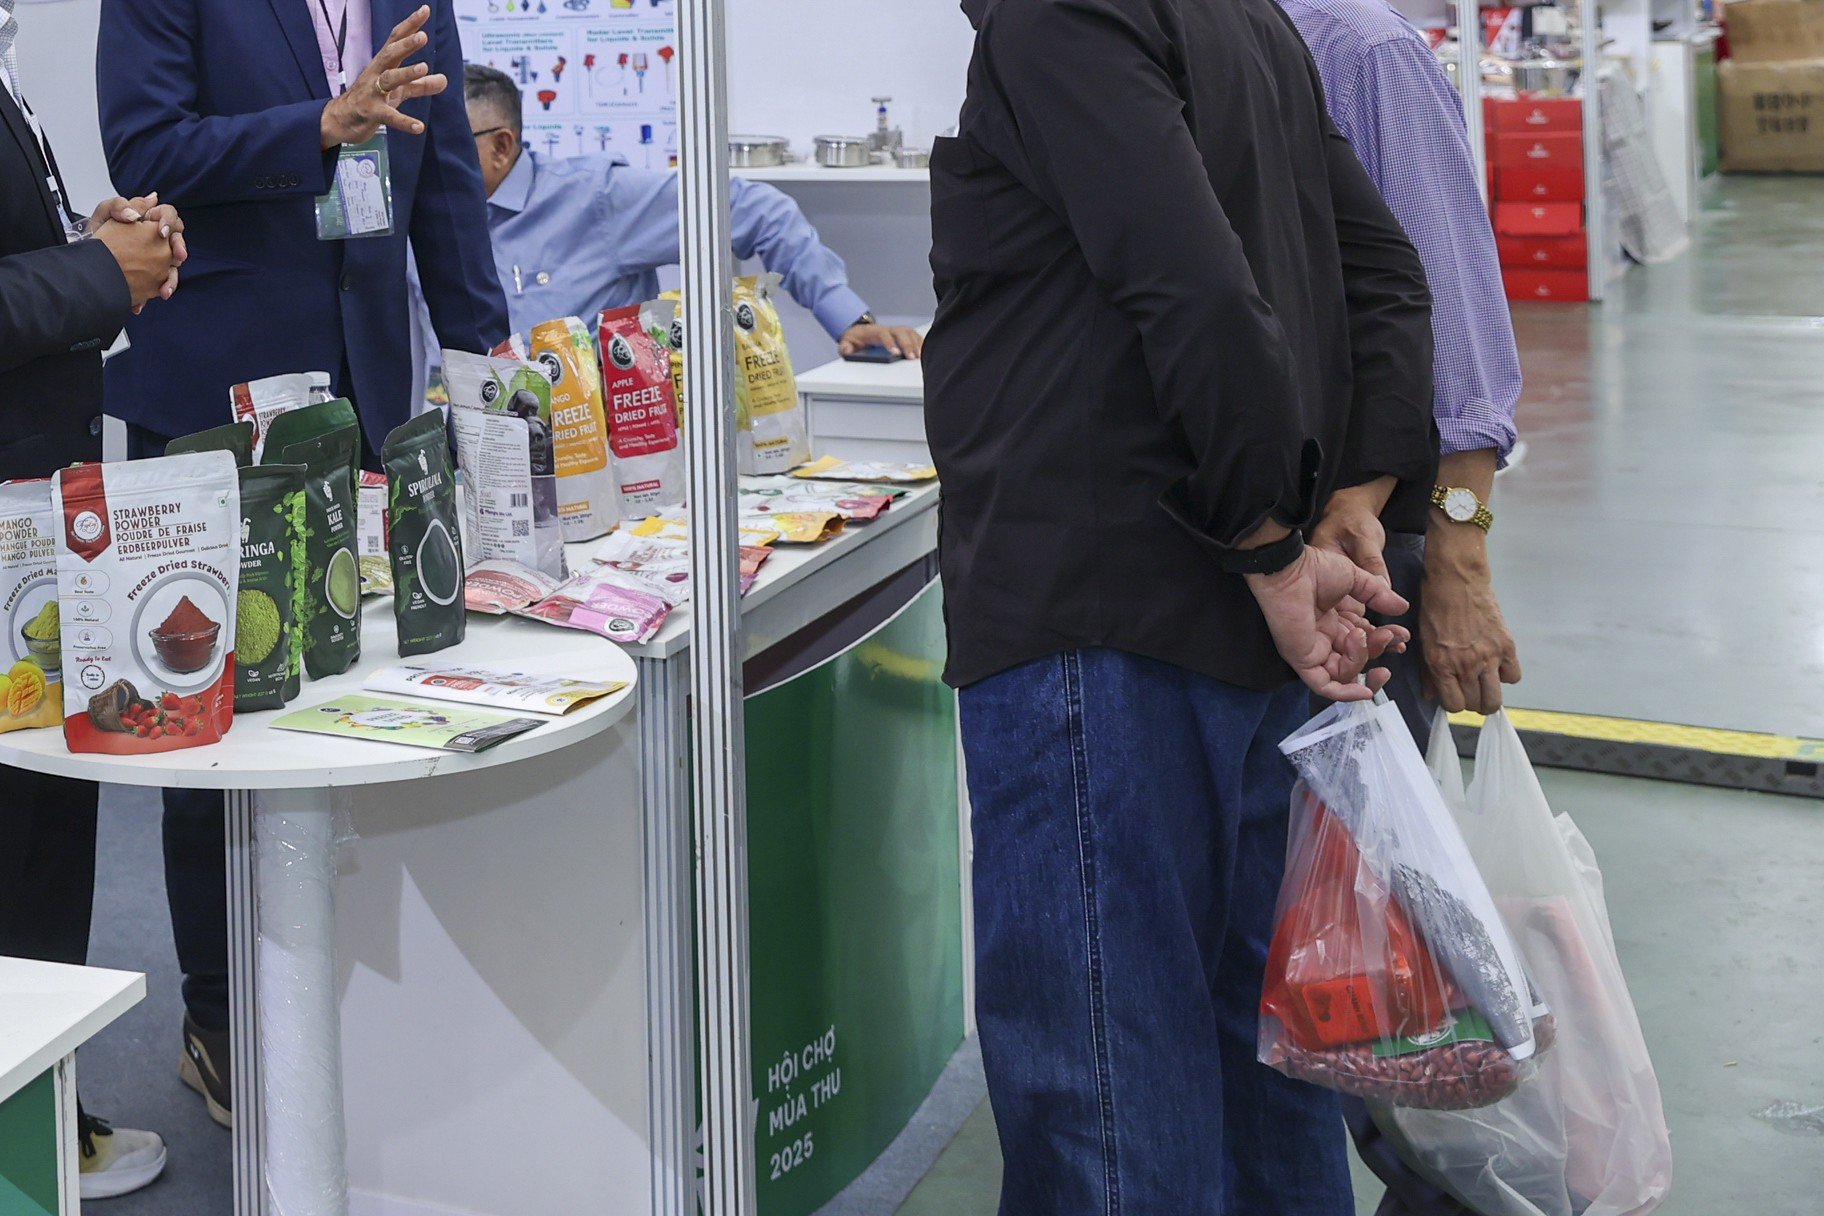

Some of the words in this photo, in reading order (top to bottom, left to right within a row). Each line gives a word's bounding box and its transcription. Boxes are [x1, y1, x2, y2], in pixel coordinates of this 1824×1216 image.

[611, 378, 634, 389] APPLE
[748, 371, 772, 383] DRIED
[551, 393, 570, 404] ANGO
[613, 386, 663, 410] FREEZE
[555, 403, 592, 426] REEZE
[615, 409, 646, 424] DRIED
[649, 403, 668, 417] FRUIT
[555, 429, 577, 441] RIED
[579, 422, 597, 436] FRUIT
[113, 503, 181, 521] STRAWBERRY
[327, 509, 343, 526] KALE
[115, 517, 161, 531] POWDER
[116, 529, 153, 542] POUDRE
[158, 527, 170, 537] DE
[176, 522, 207, 535] FRAISE
[0, 528, 38, 542] POWDER
[0, 541, 27, 552] MANGUE
[31, 538, 56, 548] POUDR
[118, 537, 190, 555] ERDBEERPULVER
[1, 551, 26, 562] MANGO
[30, 548, 55, 559] PULVER
[127, 571, 157, 601] Freeze
[157, 560, 187, 575] Dried
[3, 583, 23, 612] Freeze
[22, 568, 44, 585] Dried
[768, 1050, 798, 1093] HỘI
[802, 1024, 835, 1070] CHỢ
[769, 1092, 807, 1136] MÙA
[811, 1067, 841, 1109] THU
[770, 1131, 814, 1181] 2025
